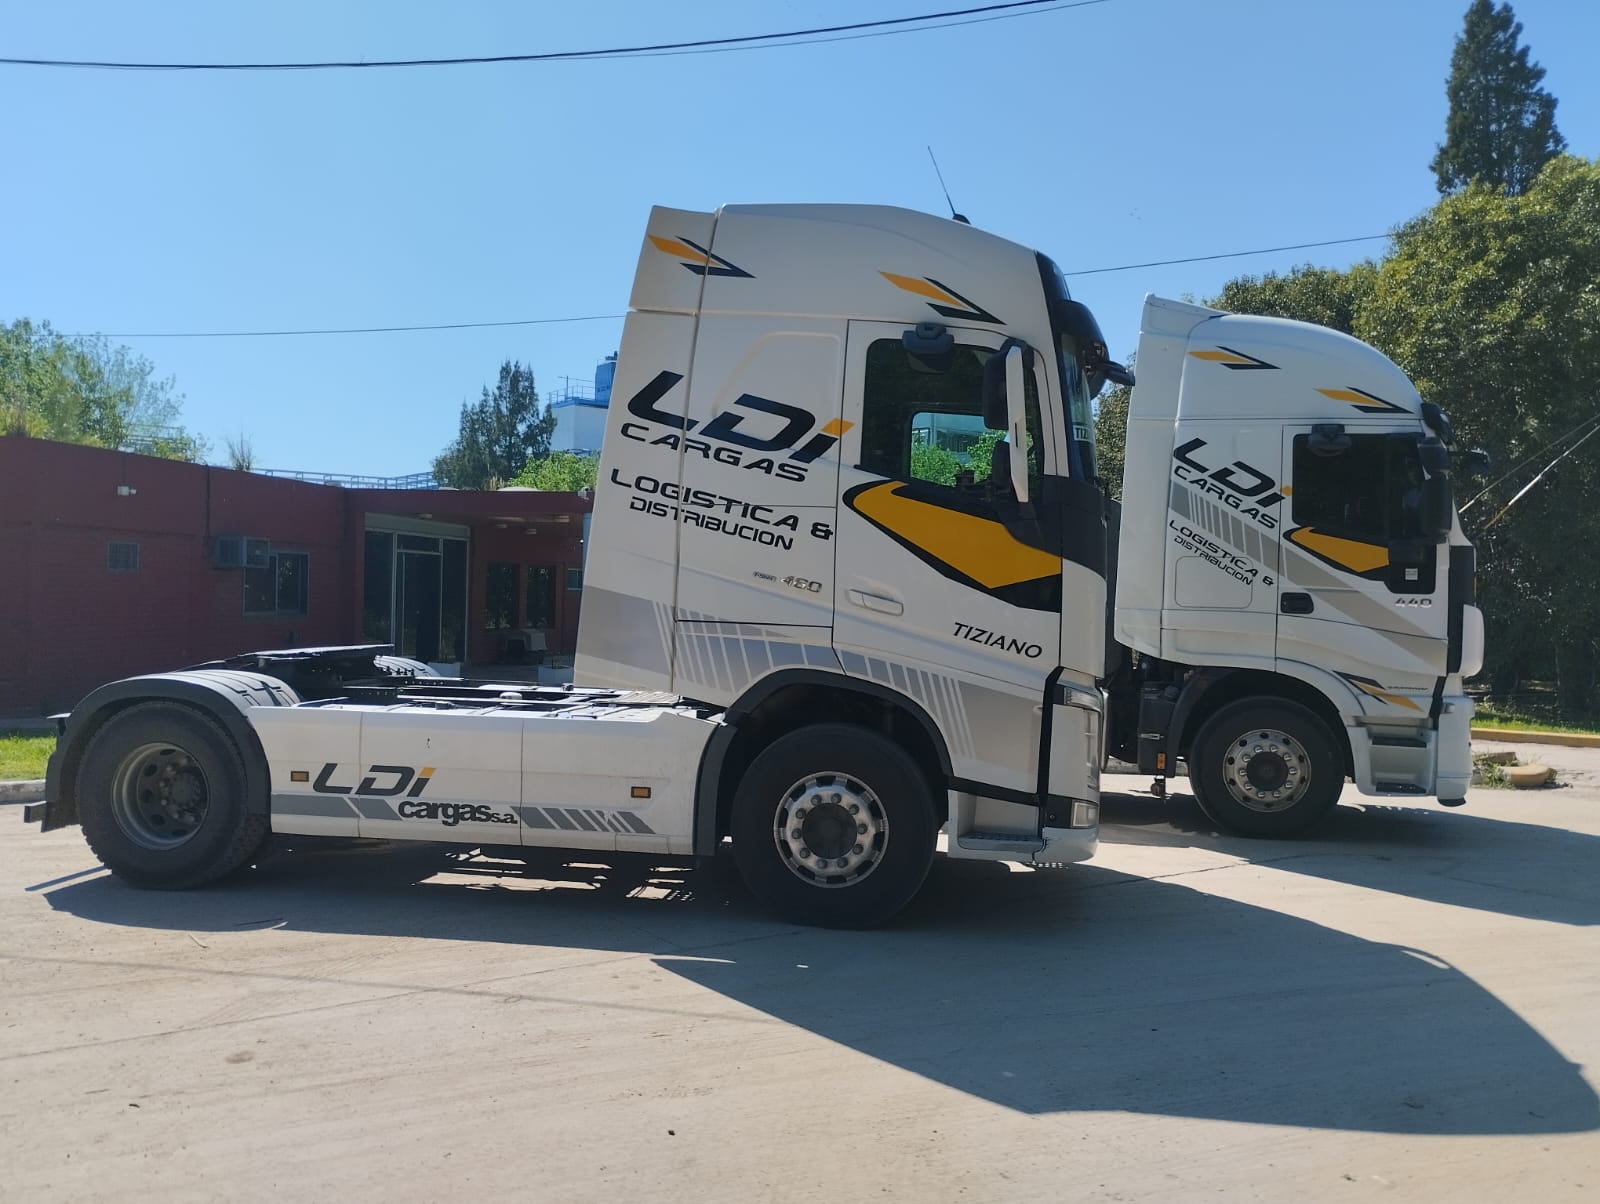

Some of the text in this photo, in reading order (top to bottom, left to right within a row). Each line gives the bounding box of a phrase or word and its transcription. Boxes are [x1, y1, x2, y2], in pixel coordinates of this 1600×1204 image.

[628, 370, 854, 463] LDi
[621, 422, 808, 482] CARGAS
[611, 468, 833, 541] LOGISTICA &
[630, 496, 794, 550] DISTRIBUCION
[1174, 465, 1278, 529] CARGAS
[1169, 520, 1274, 586] LOGISTICA &
[1174, 535, 1253, 585] DISTRIBUCION
[953, 622, 1043, 658] TIZIANO
[313, 763, 436, 797] LDi
